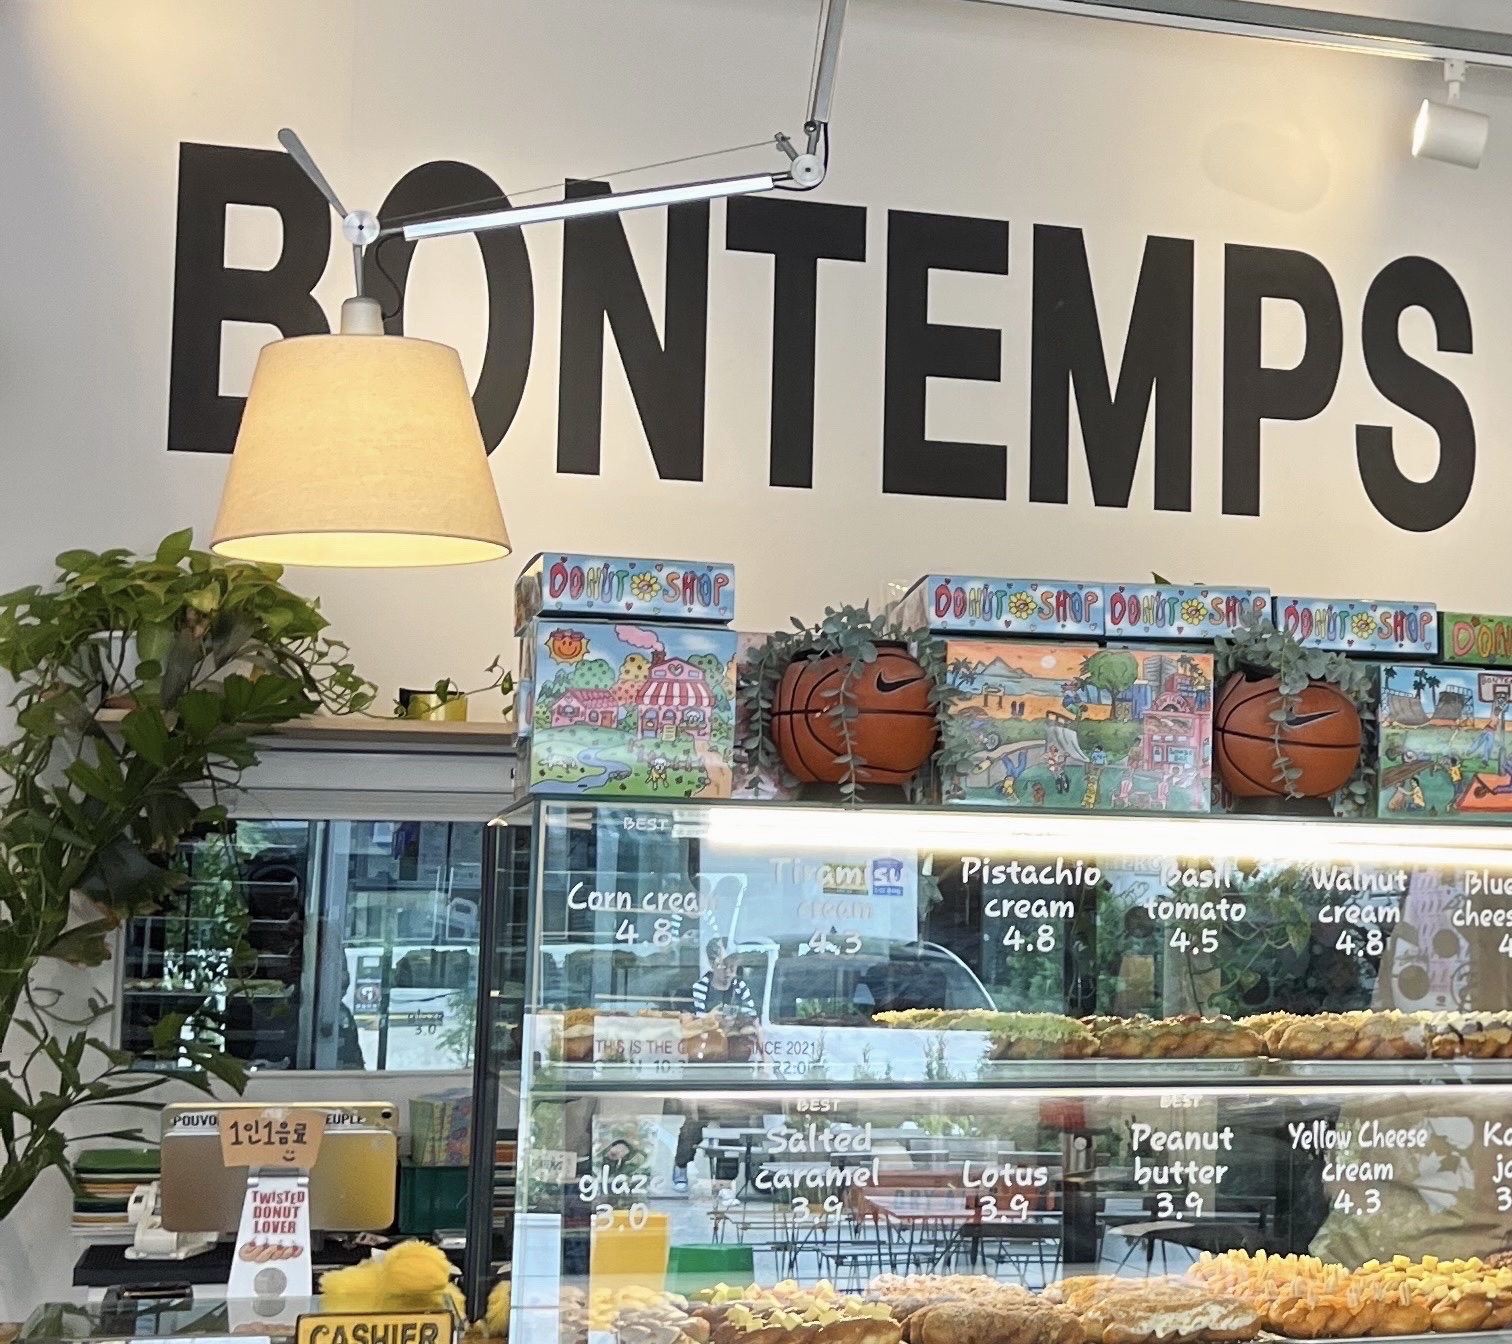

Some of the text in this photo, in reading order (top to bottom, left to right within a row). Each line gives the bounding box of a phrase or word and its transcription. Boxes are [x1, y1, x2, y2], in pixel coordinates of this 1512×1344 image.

[167, 142, 1477, 532] BONTEMPS
[550, 561, 730, 607] DONUT SHOP
[935, 583, 1098, 623] DONUT SHOP
[1110, 590, 1267, 628] DONUT SHOP
[1284, 605, 1433, 643] DONUT SHOP
[623, 817, 669, 831] BEST
[769, 857, 905, 886] Tiramisu
[961, 857, 1100, 886] Pistachio
[1160, 857, 1232, 889] Basil
[1312, 865, 1408, 892] Walnut
[567, 882, 632, 910] Corn
[984, 897, 1075, 918] cream
[1145, 898, 1247, 922] tomato
[1319, 903, 1400, 923] cream
[615, 918, 672, 947] 4.8
[808, 929, 862, 955] 4.3
[1003, 924, 1056, 953] 4.8
[1169, 927, 1219, 955] 4.5
[1335, 929, 1384, 957] 4.8
[629, 1040, 642, 1054] IS
[646, 1040, 673, 1054] THE
[749, 1040, 816, 1056] INCE 2021
[796, 1099, 841, 1112] BEST
[173, 1114, 363, 1126] POUVO EUPLE
[230, 1119, 308, 1146] 1인1음료
[767, 1122, 872, 1154] Salted
[1131, 1123, 1234, 1152] Peanut
[1288, 1120, 1428, 1150] Yellow Cheese
[578, 1164, 665, 1202] glaze
[755, 1157, 880, 1191] caramel
[962, 1160, 1048, 1188] Lotus
[1134, 1156, 1229, 1186] butter
[1321, 1161, 1394, 1182] cream
[251, 1190, 306, 1205] TWISTED
[791, 1195, 844, 1225] 3.9
[979, 1194, 1031, 1222] 3.9
[1156, 1191, 1203, 1220] 3.9
[1333, 1188, 1381, 1216] 4.3
[253, 1206, 300, 1219] DONUT
[594, 1202, 649, 1232] 3.0
[254, 1221, 296, 1234] LOVER
